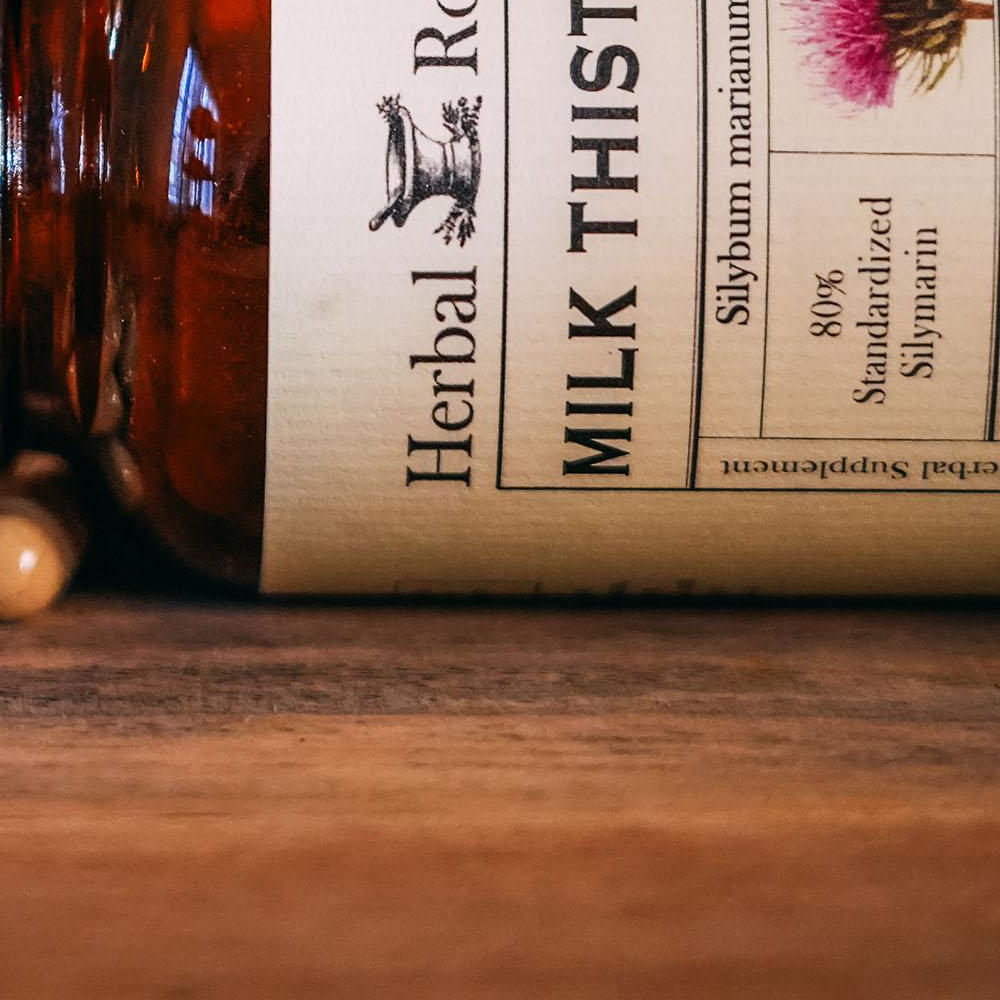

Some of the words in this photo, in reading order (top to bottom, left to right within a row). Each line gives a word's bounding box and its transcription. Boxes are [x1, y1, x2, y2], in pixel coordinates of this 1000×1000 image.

[716, 180, 758, 325] Silybum
[810, 270, 846, 337] 80%
[853, 197, 892, 404] Standardized
[900, 227, 942, 378] Silymarin
[405, 266, 477, 488] Herbal
[563, 286, 639, 477] MILK
[720, 456, 909, 481] Supplement
[922, 460, 1000, 481] erbal
